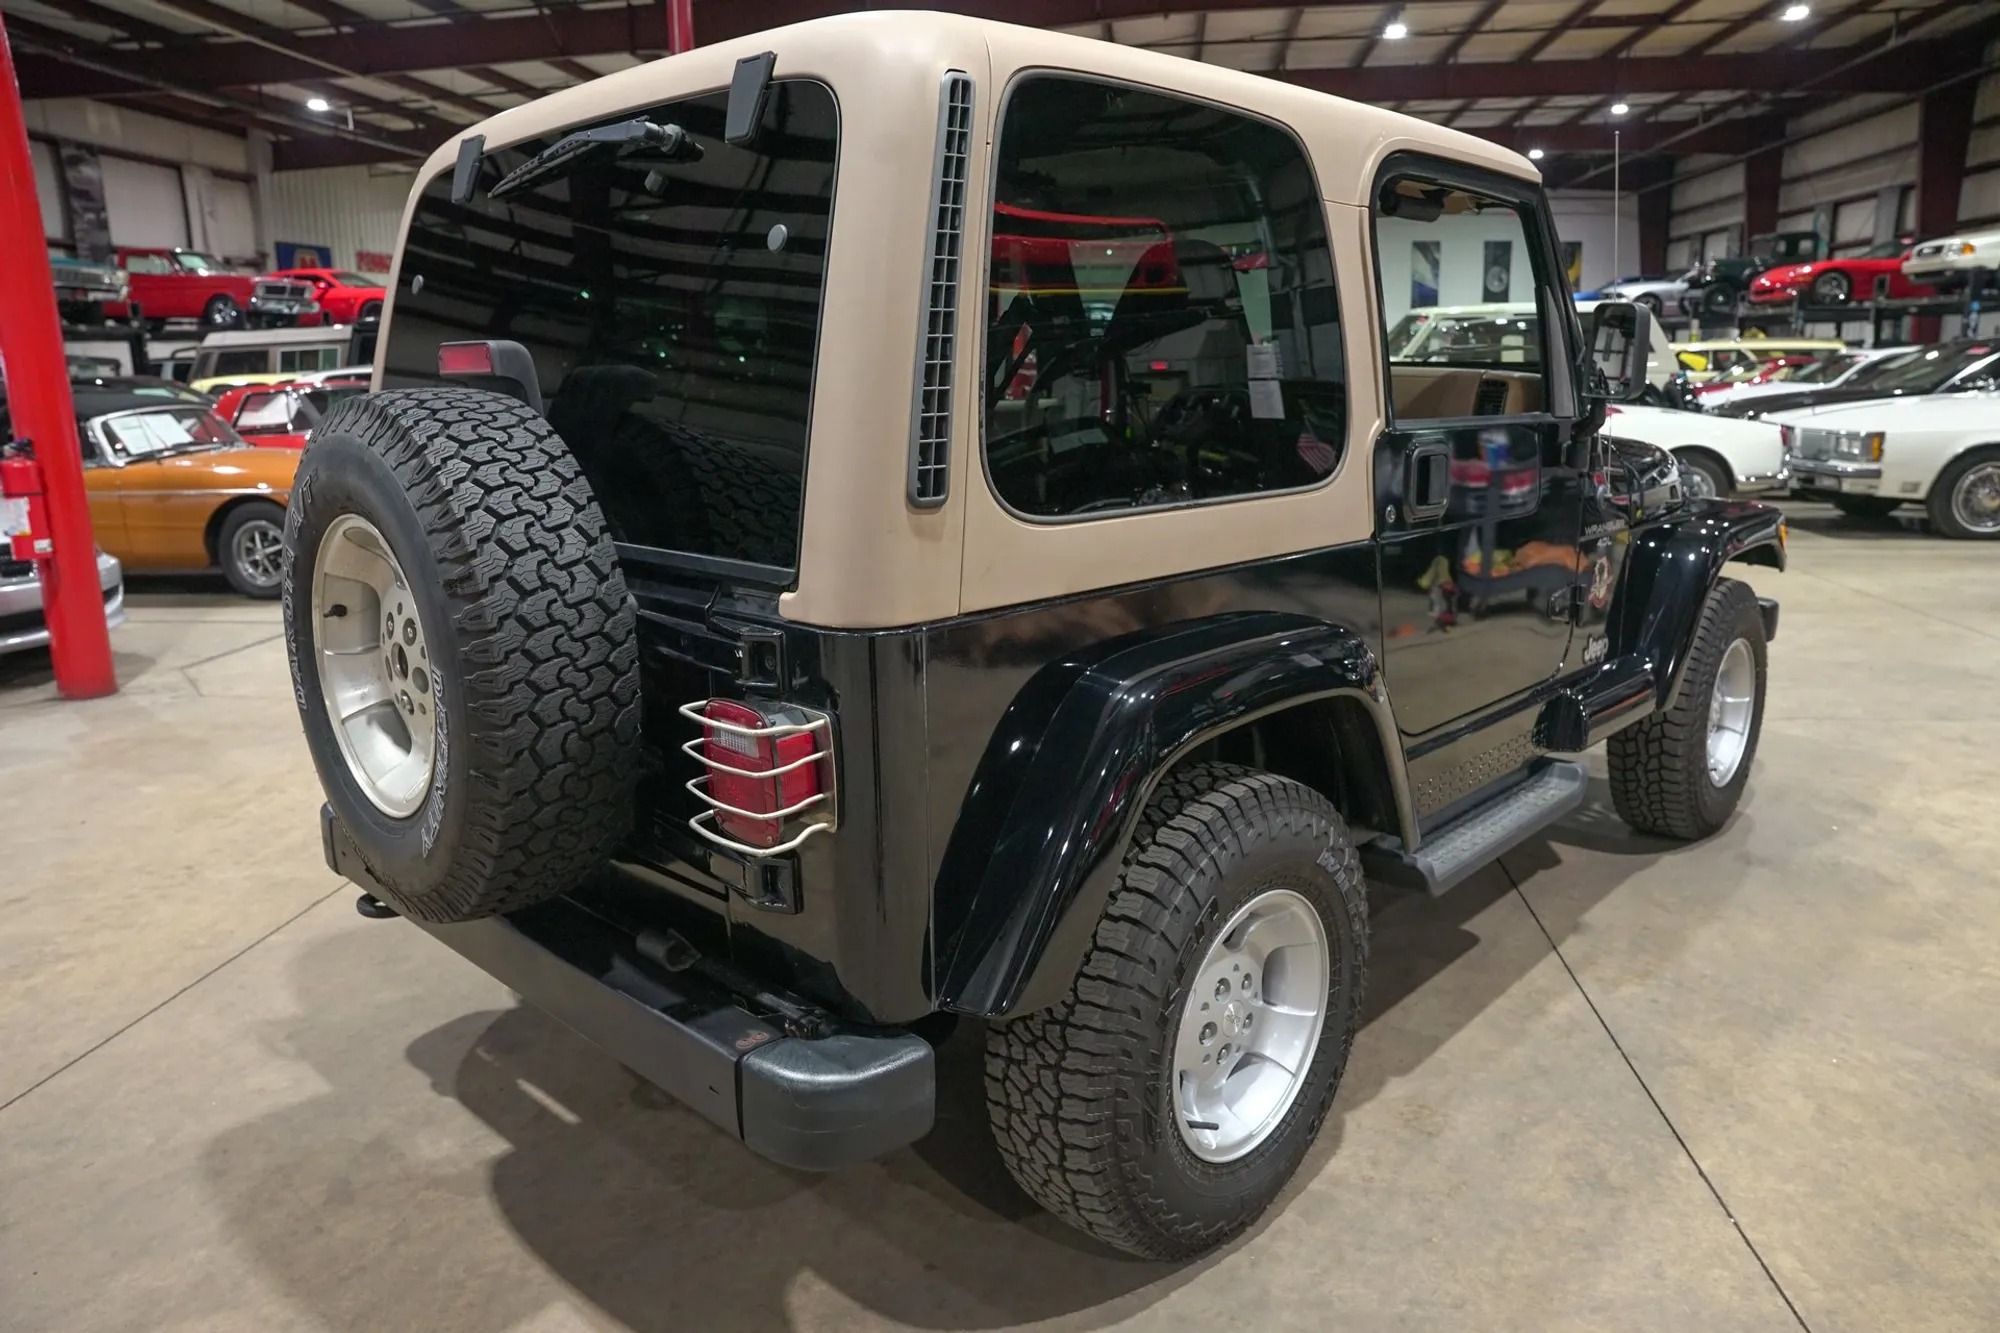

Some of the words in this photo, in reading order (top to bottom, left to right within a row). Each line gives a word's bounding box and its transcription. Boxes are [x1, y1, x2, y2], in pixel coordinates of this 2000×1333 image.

[284, 543, 308, 710] DAKOTA
[1583, 635, 1609, 663] Jeep
[421, 662, 449, 858] DEFINITY
